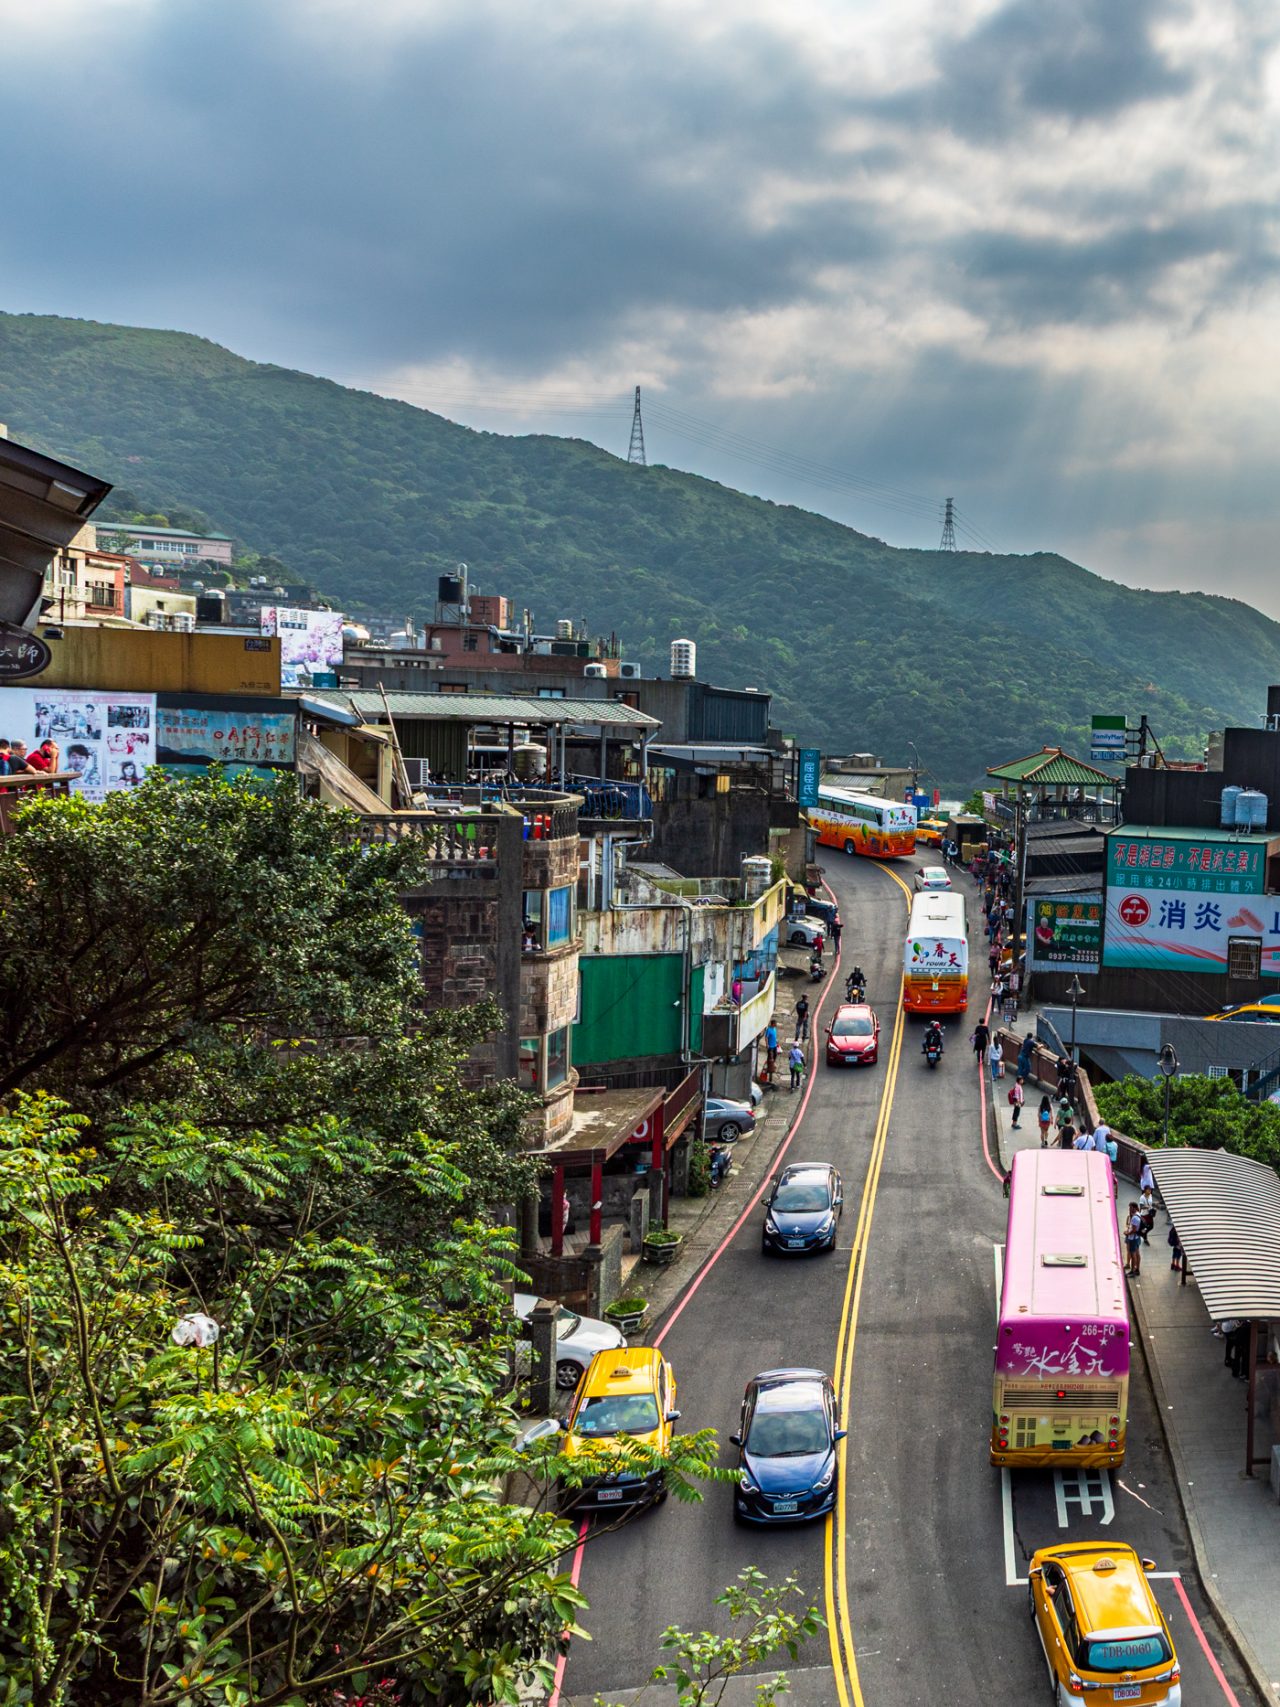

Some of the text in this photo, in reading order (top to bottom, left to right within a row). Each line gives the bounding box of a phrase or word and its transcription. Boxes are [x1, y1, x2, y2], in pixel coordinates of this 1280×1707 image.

[1093, 733, 1124, 741] FamilyMart
[1158, 899, 1222, 932] 消炎
[932, 942, 963, 968] 春天
[1082, 1324, 1116, 1336] 266-FQ
[1102, 1643, 1152, 1659] TDB-0060
